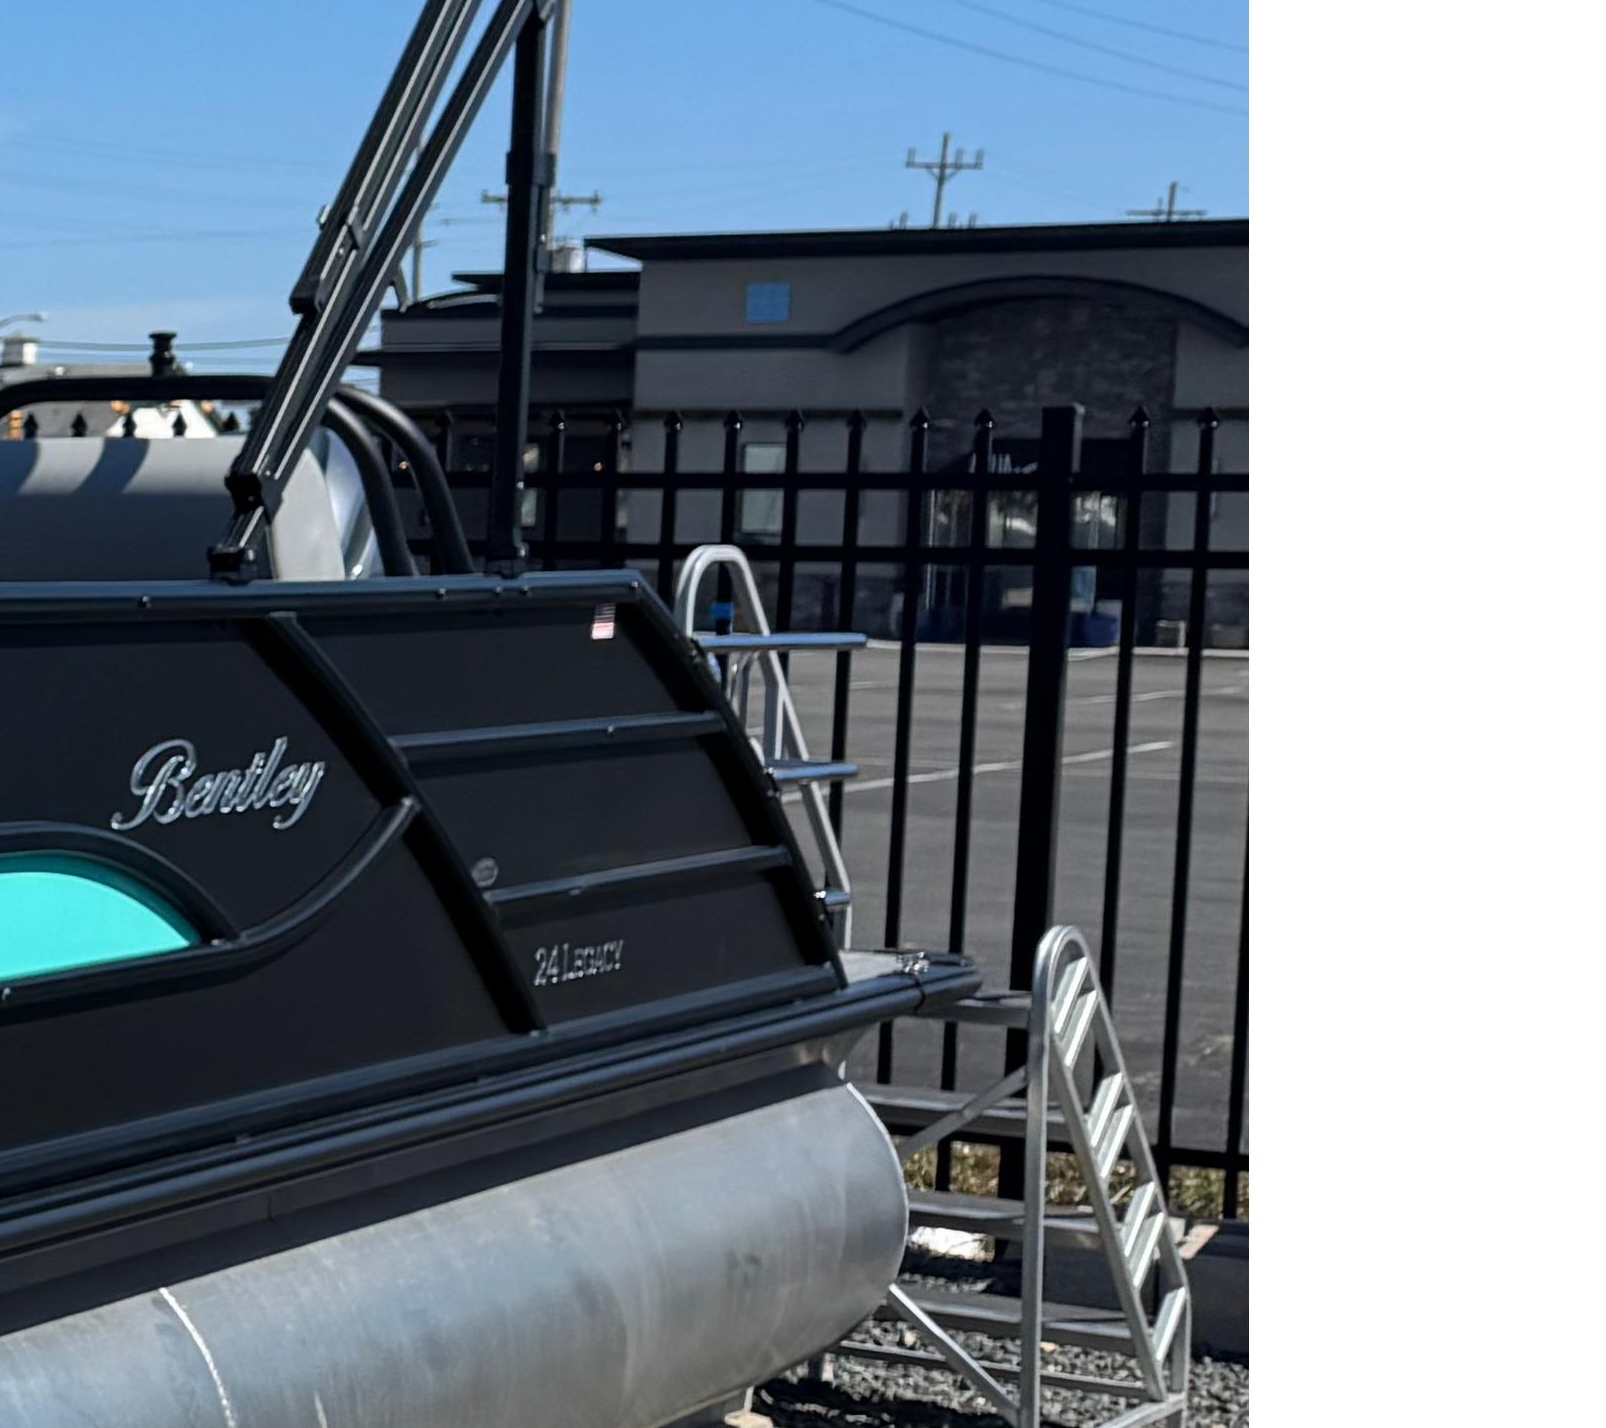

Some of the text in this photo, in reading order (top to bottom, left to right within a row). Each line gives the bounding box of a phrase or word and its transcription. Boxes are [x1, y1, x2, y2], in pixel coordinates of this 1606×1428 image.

[110, 735, 326, 830] Bentley
[533, 939, 624, 986] 24 LEGACY
